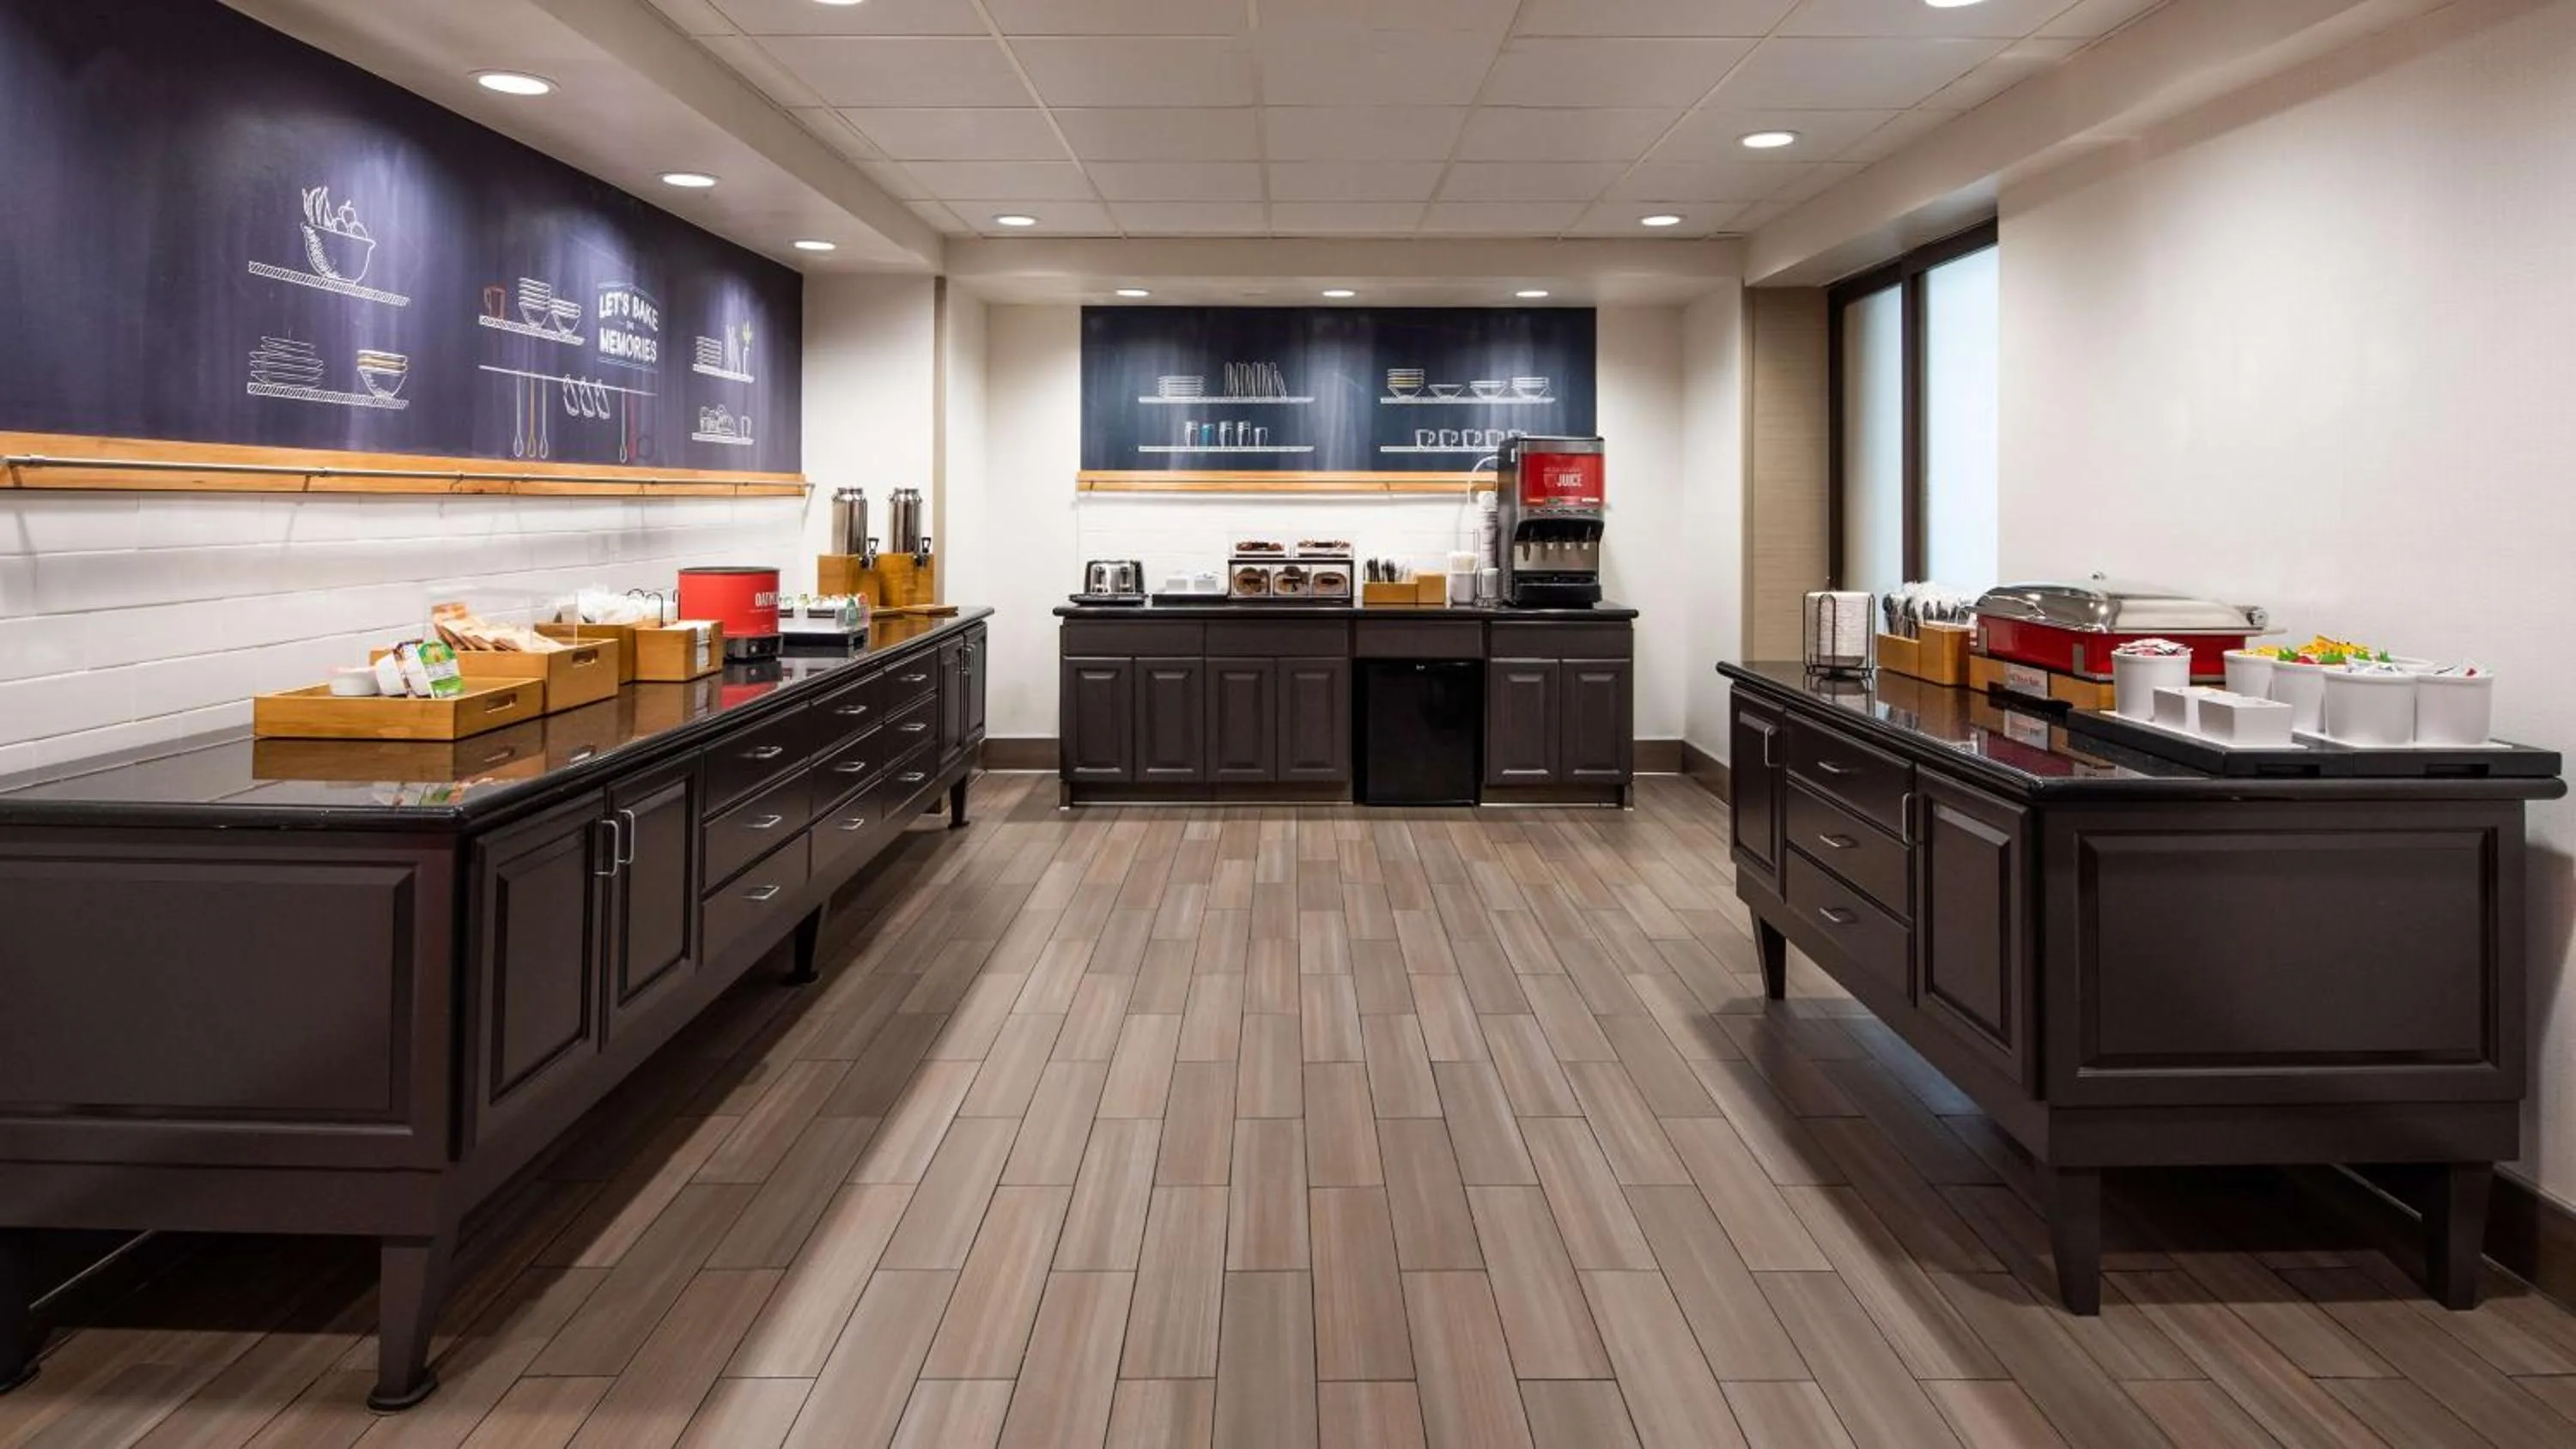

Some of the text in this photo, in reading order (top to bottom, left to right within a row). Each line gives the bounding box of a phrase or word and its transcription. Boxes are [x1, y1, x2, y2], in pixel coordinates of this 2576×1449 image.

[598, 291, 659, 332] LET'S BAKE
[599, 327, 658, 363] MEMORIES
[1557, 473, 1583, 488] JUICE
